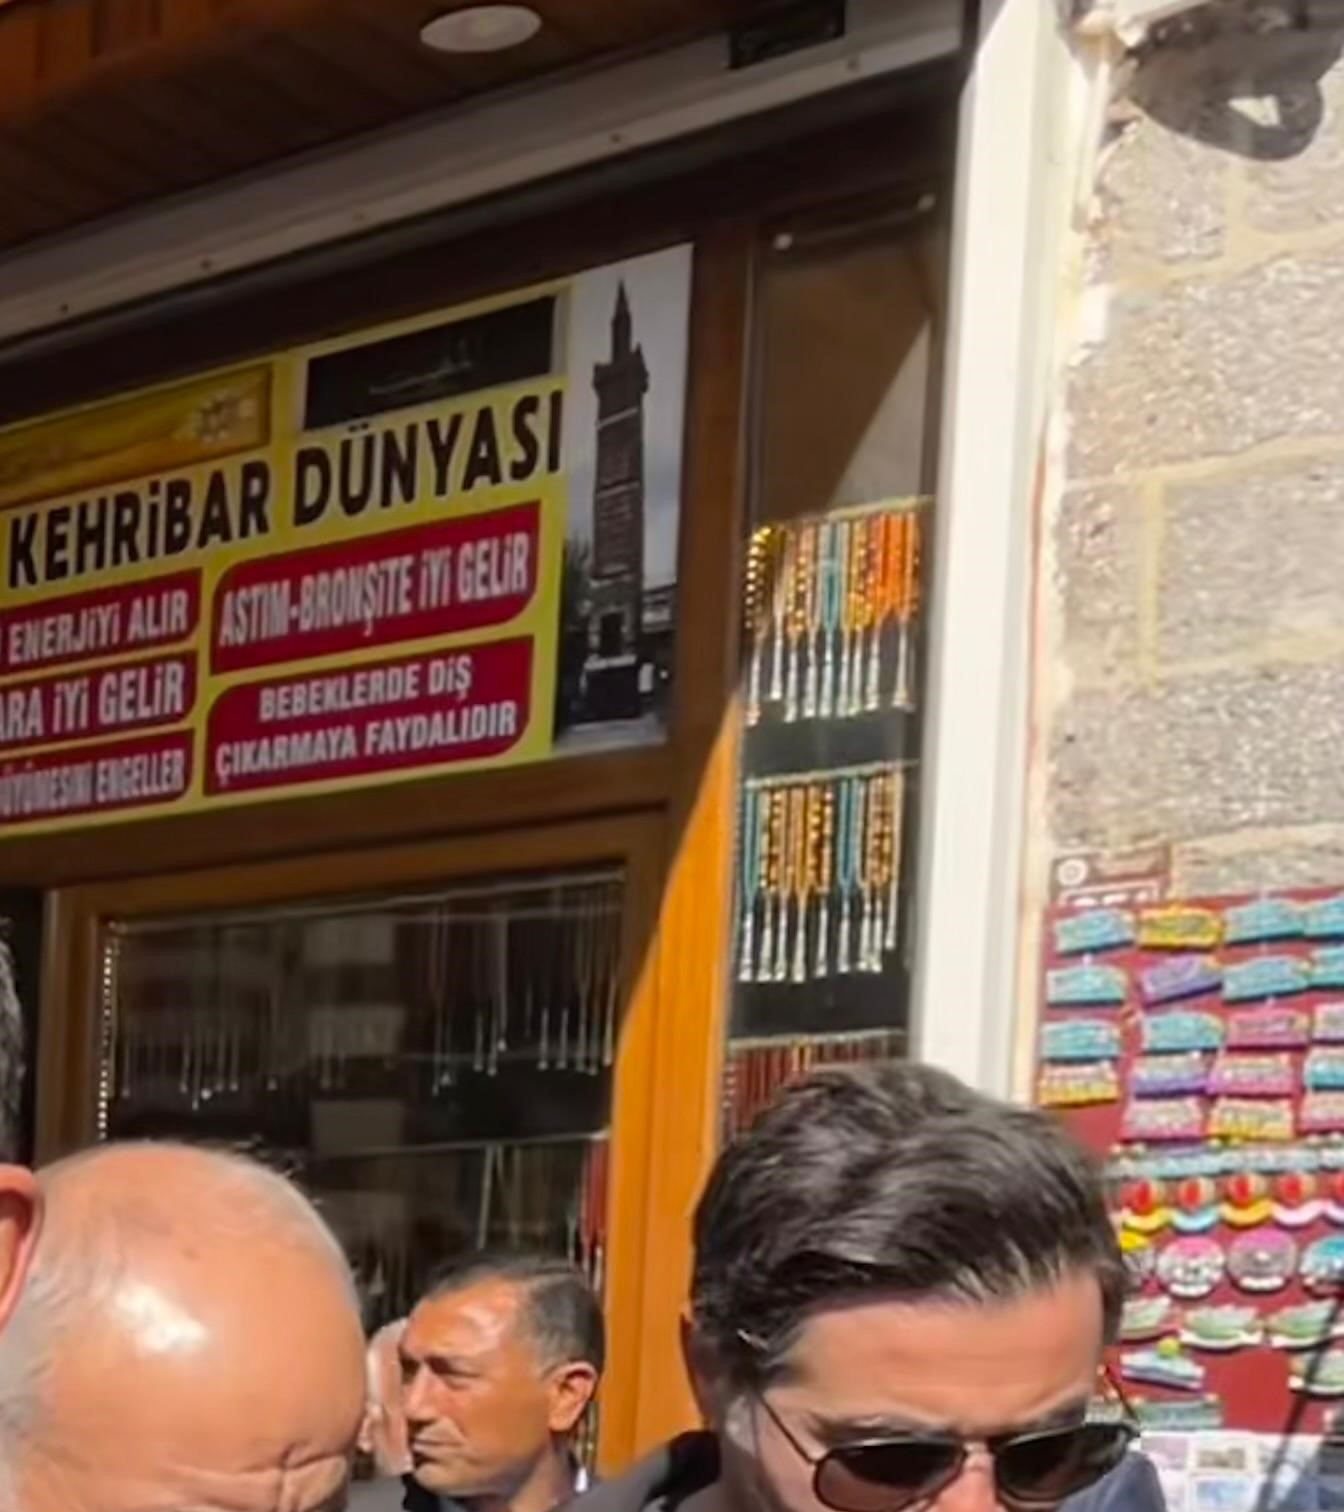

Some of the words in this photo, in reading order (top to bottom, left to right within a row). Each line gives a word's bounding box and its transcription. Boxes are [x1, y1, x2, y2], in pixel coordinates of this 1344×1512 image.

[9, 460, 270, 590] KEHRİBAR
[293, 388, 564, 528] DÜNYASI
[126, 589, 190, 643] ALIR
[258, 663, 421, 723] BEBEKLERDE
[428, 654, 473, 702] DİŞ
[215, 725, 358, 788] ÇIKARMAYA
[364, 700, 518, 757] FAYDALIDIR
